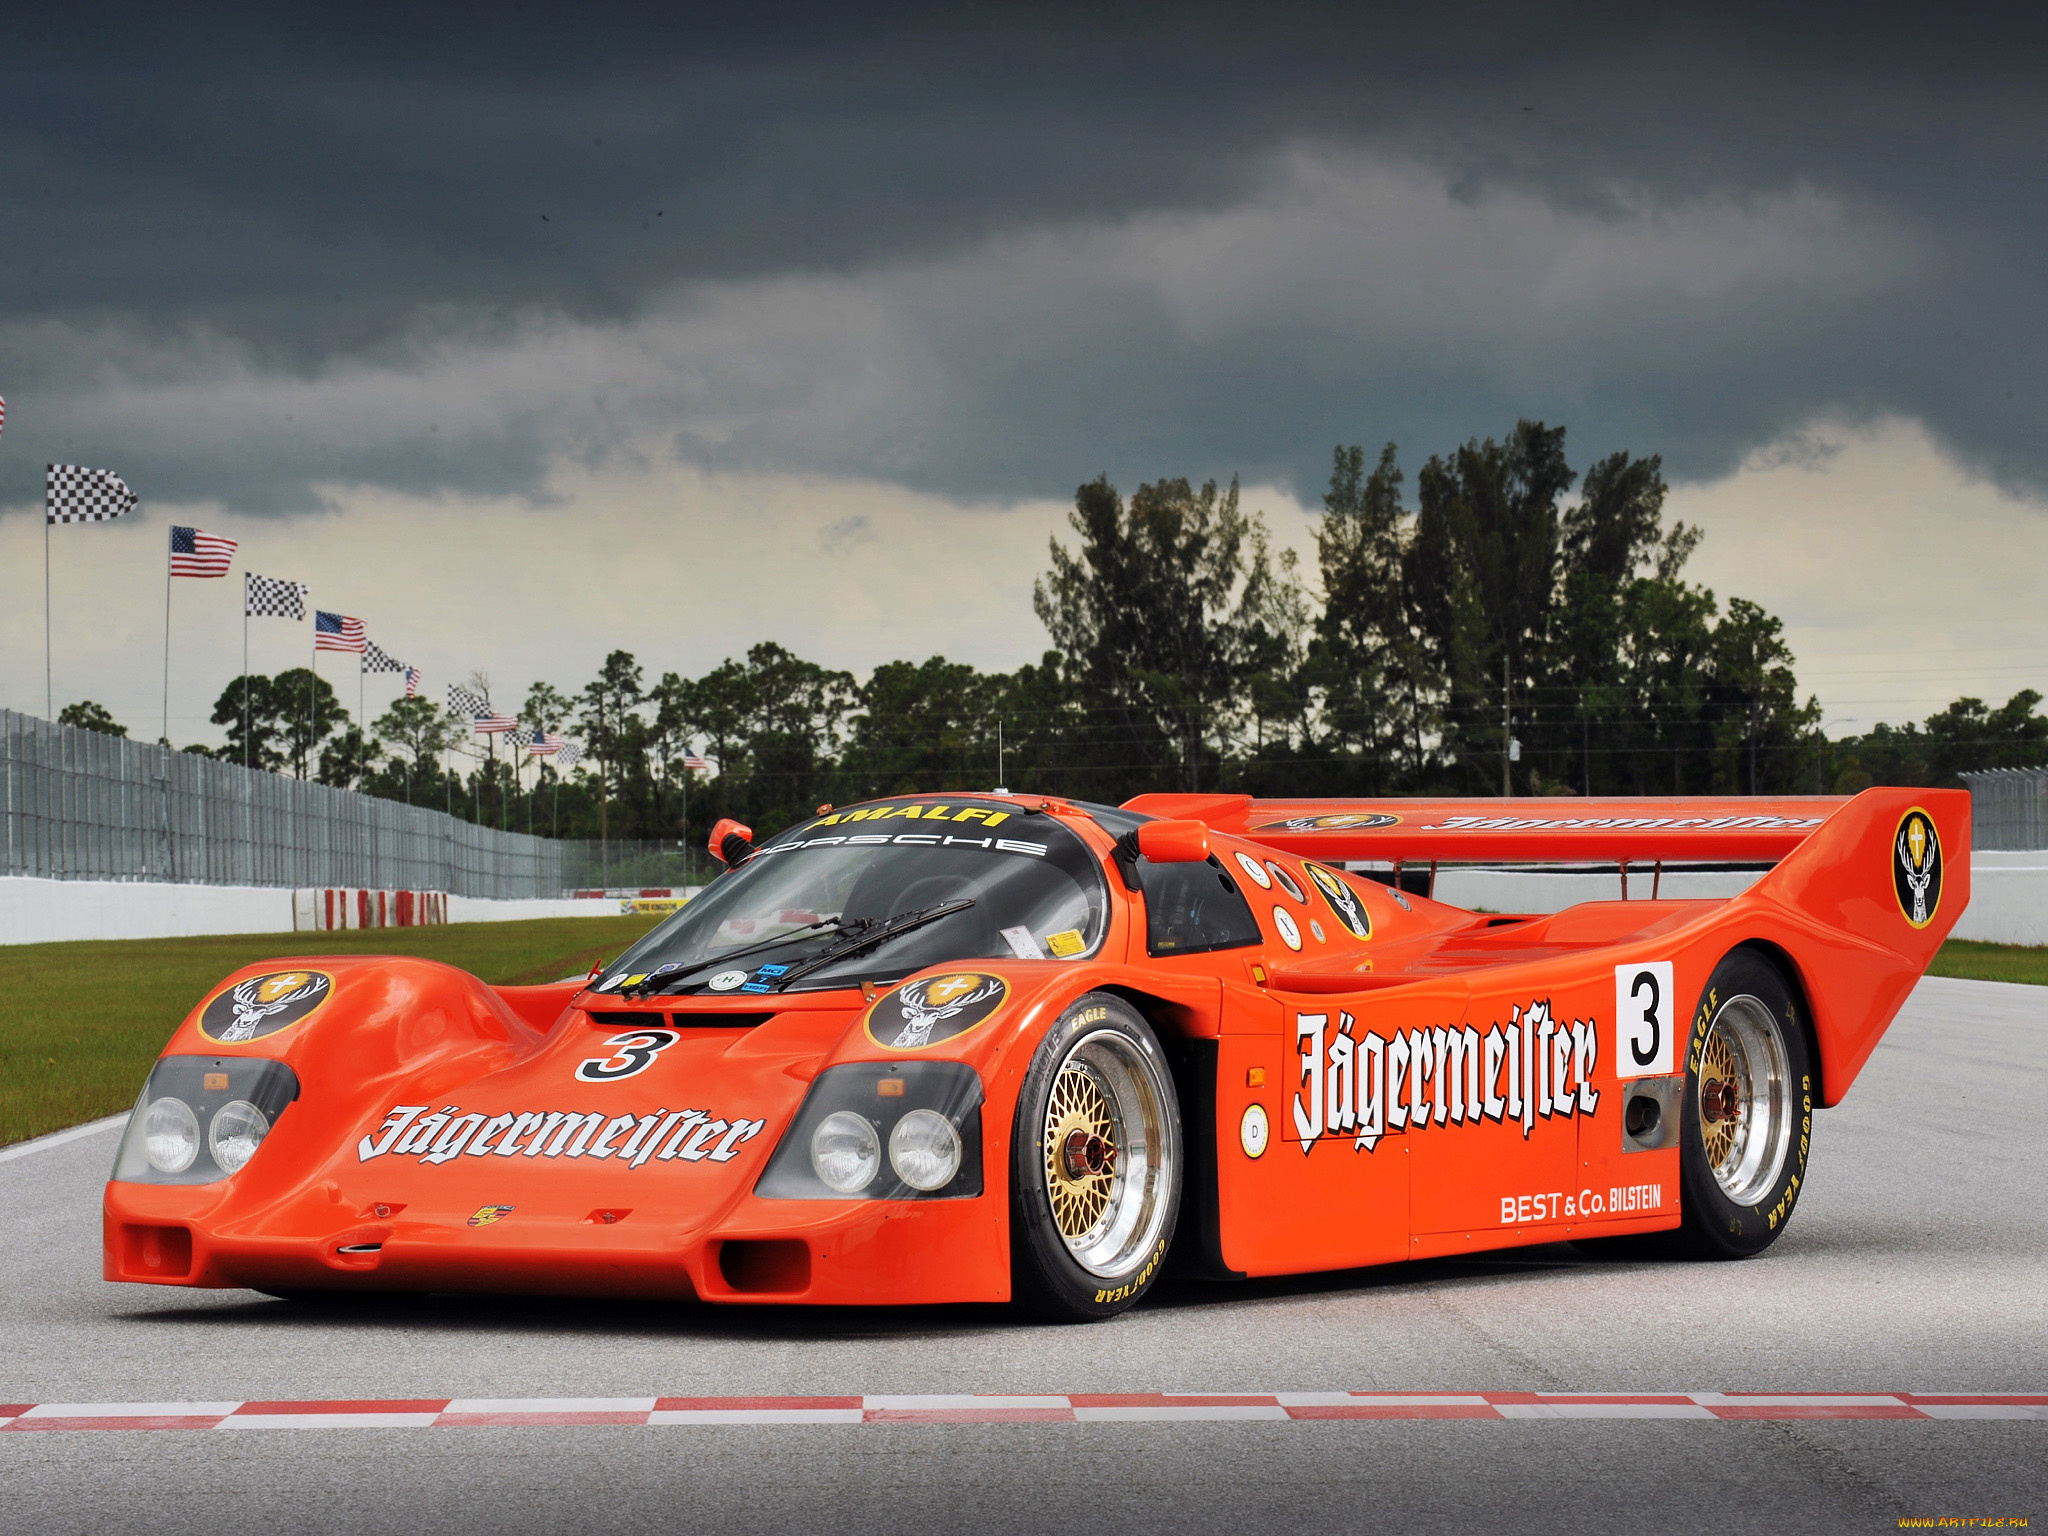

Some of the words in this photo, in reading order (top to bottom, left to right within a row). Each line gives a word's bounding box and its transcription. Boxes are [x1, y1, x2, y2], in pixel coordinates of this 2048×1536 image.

[802, 805, 1011, 831] AMALFI
[735, 834, 1048, 866] PORSCHE
[1071, 1007, 1107, 1032] EAGLE
[1630, 970, 1660, 1066] 3
[1690, 987, 1718, 1076] EAGLE
[574, 1029, 681, 1083] 3
[1292, 998, 1601, 1156] Jägermeister
[357, 1105, 767, 1169] Jägermeister
[1252, 1125, 1259, 1138] D
[1500, 1192, 1562, 1224] BEST
[1564, 1196, 1576, 1216] &
[1578, 1189, 1606, 1216] Co.
[1609, 1184, 1661, 1213] BILSTEIN
